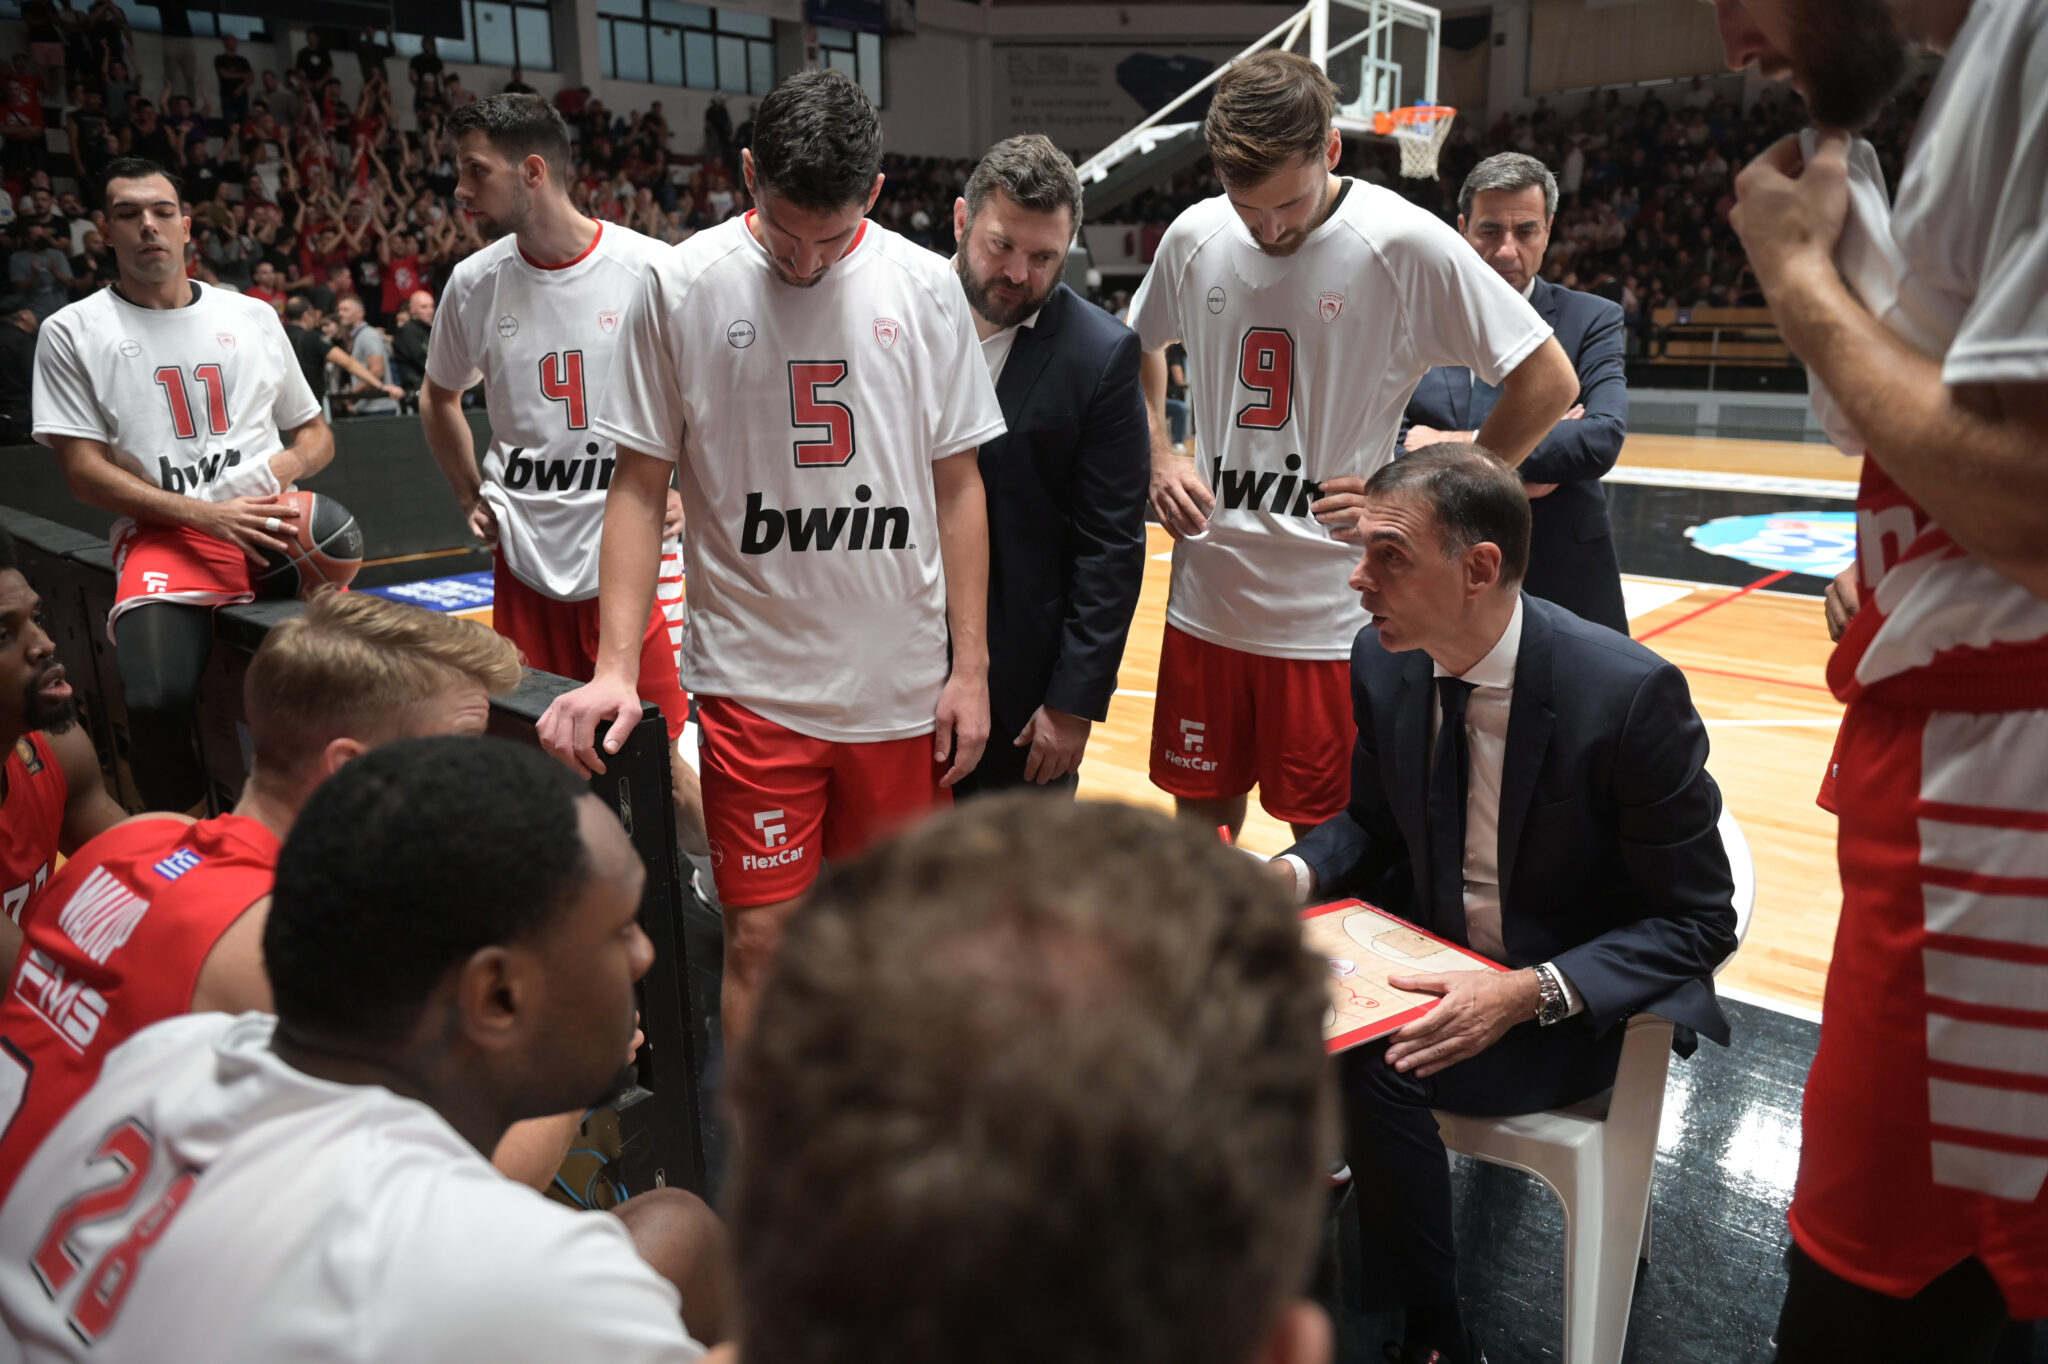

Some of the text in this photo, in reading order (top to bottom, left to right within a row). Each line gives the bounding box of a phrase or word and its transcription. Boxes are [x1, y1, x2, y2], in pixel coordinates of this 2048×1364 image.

[153, 363, 231, 439] 11
[539, 349, 588, 430] 4
[787, 359, 856, 468] 5
[1237, 326, 1295, 431] 9
[158, 449, 241, 495] bw
[740, 484, 910, 555] bwin
[1165, 749, 1218, 772] FlexCar
[742, 846, 804, 871] FlexCar
